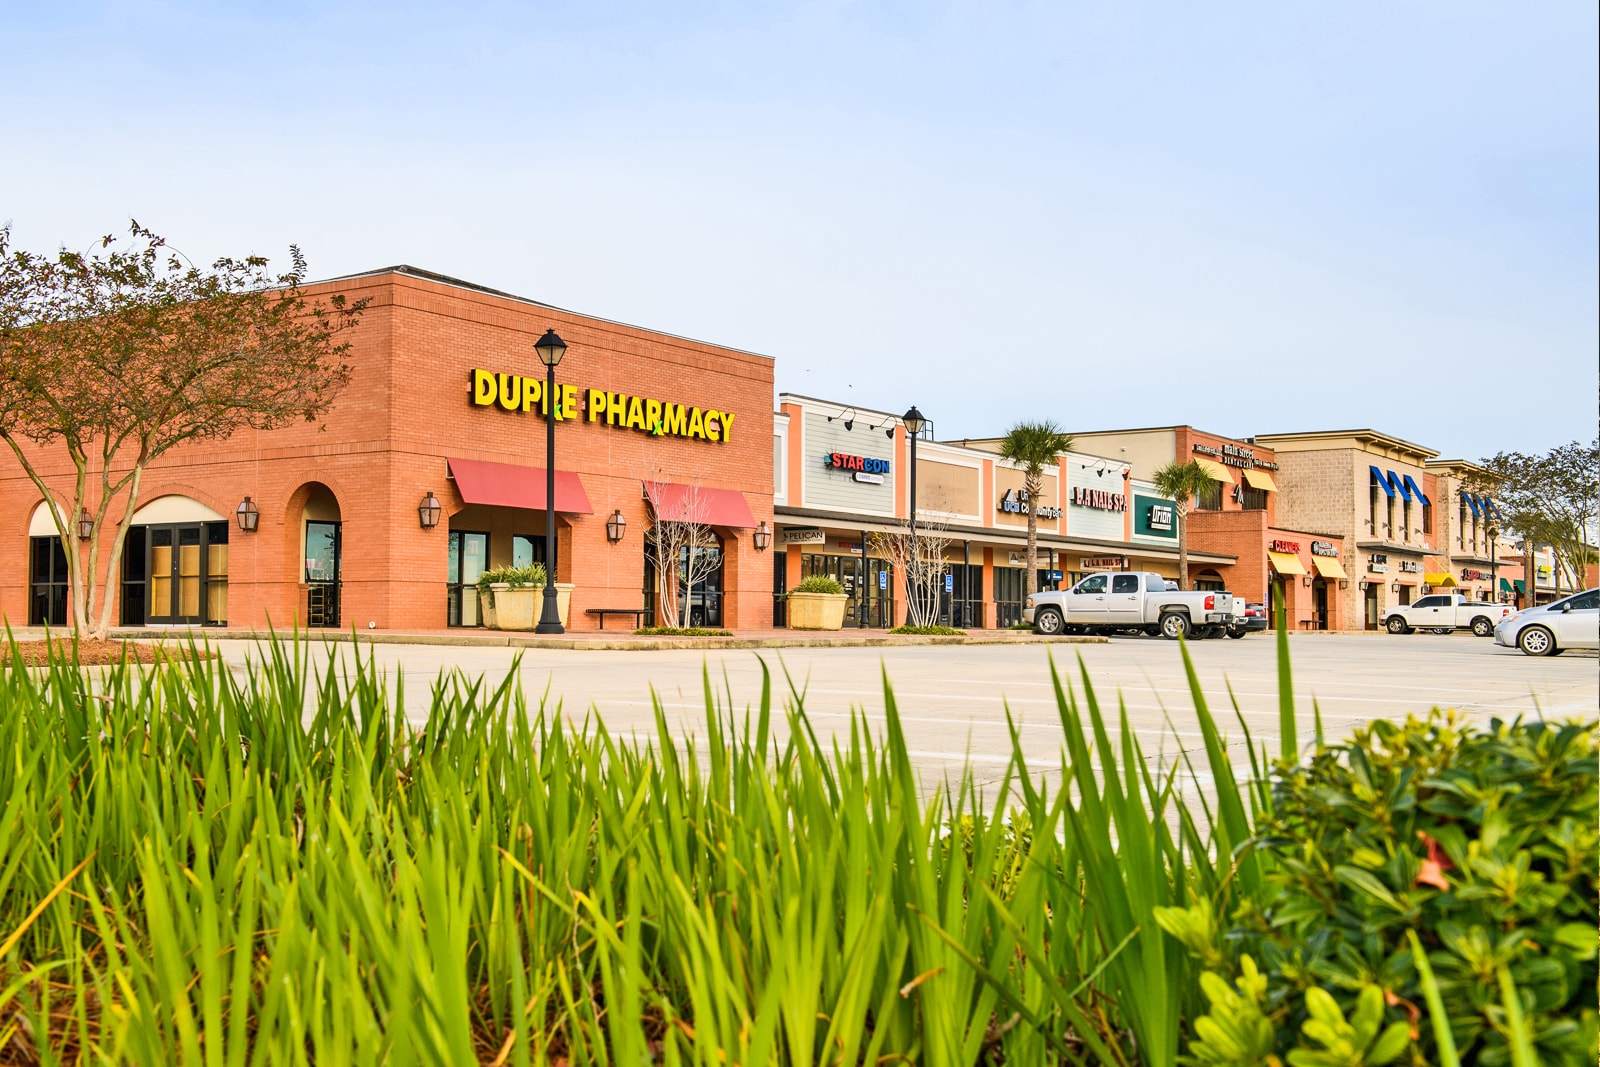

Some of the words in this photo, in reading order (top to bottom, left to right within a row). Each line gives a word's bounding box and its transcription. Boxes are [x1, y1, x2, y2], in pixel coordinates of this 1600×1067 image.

[474, 368, 578, 421] DUPRE
[588, 388, 736, 443] PHARMACY
[832, 452, 890, 473] STARCON
[1092, 489, 1112, 510] NAIL
[1113, 493, 1128, 512] SPA
[789, 531, 823, 540] PELICAN
